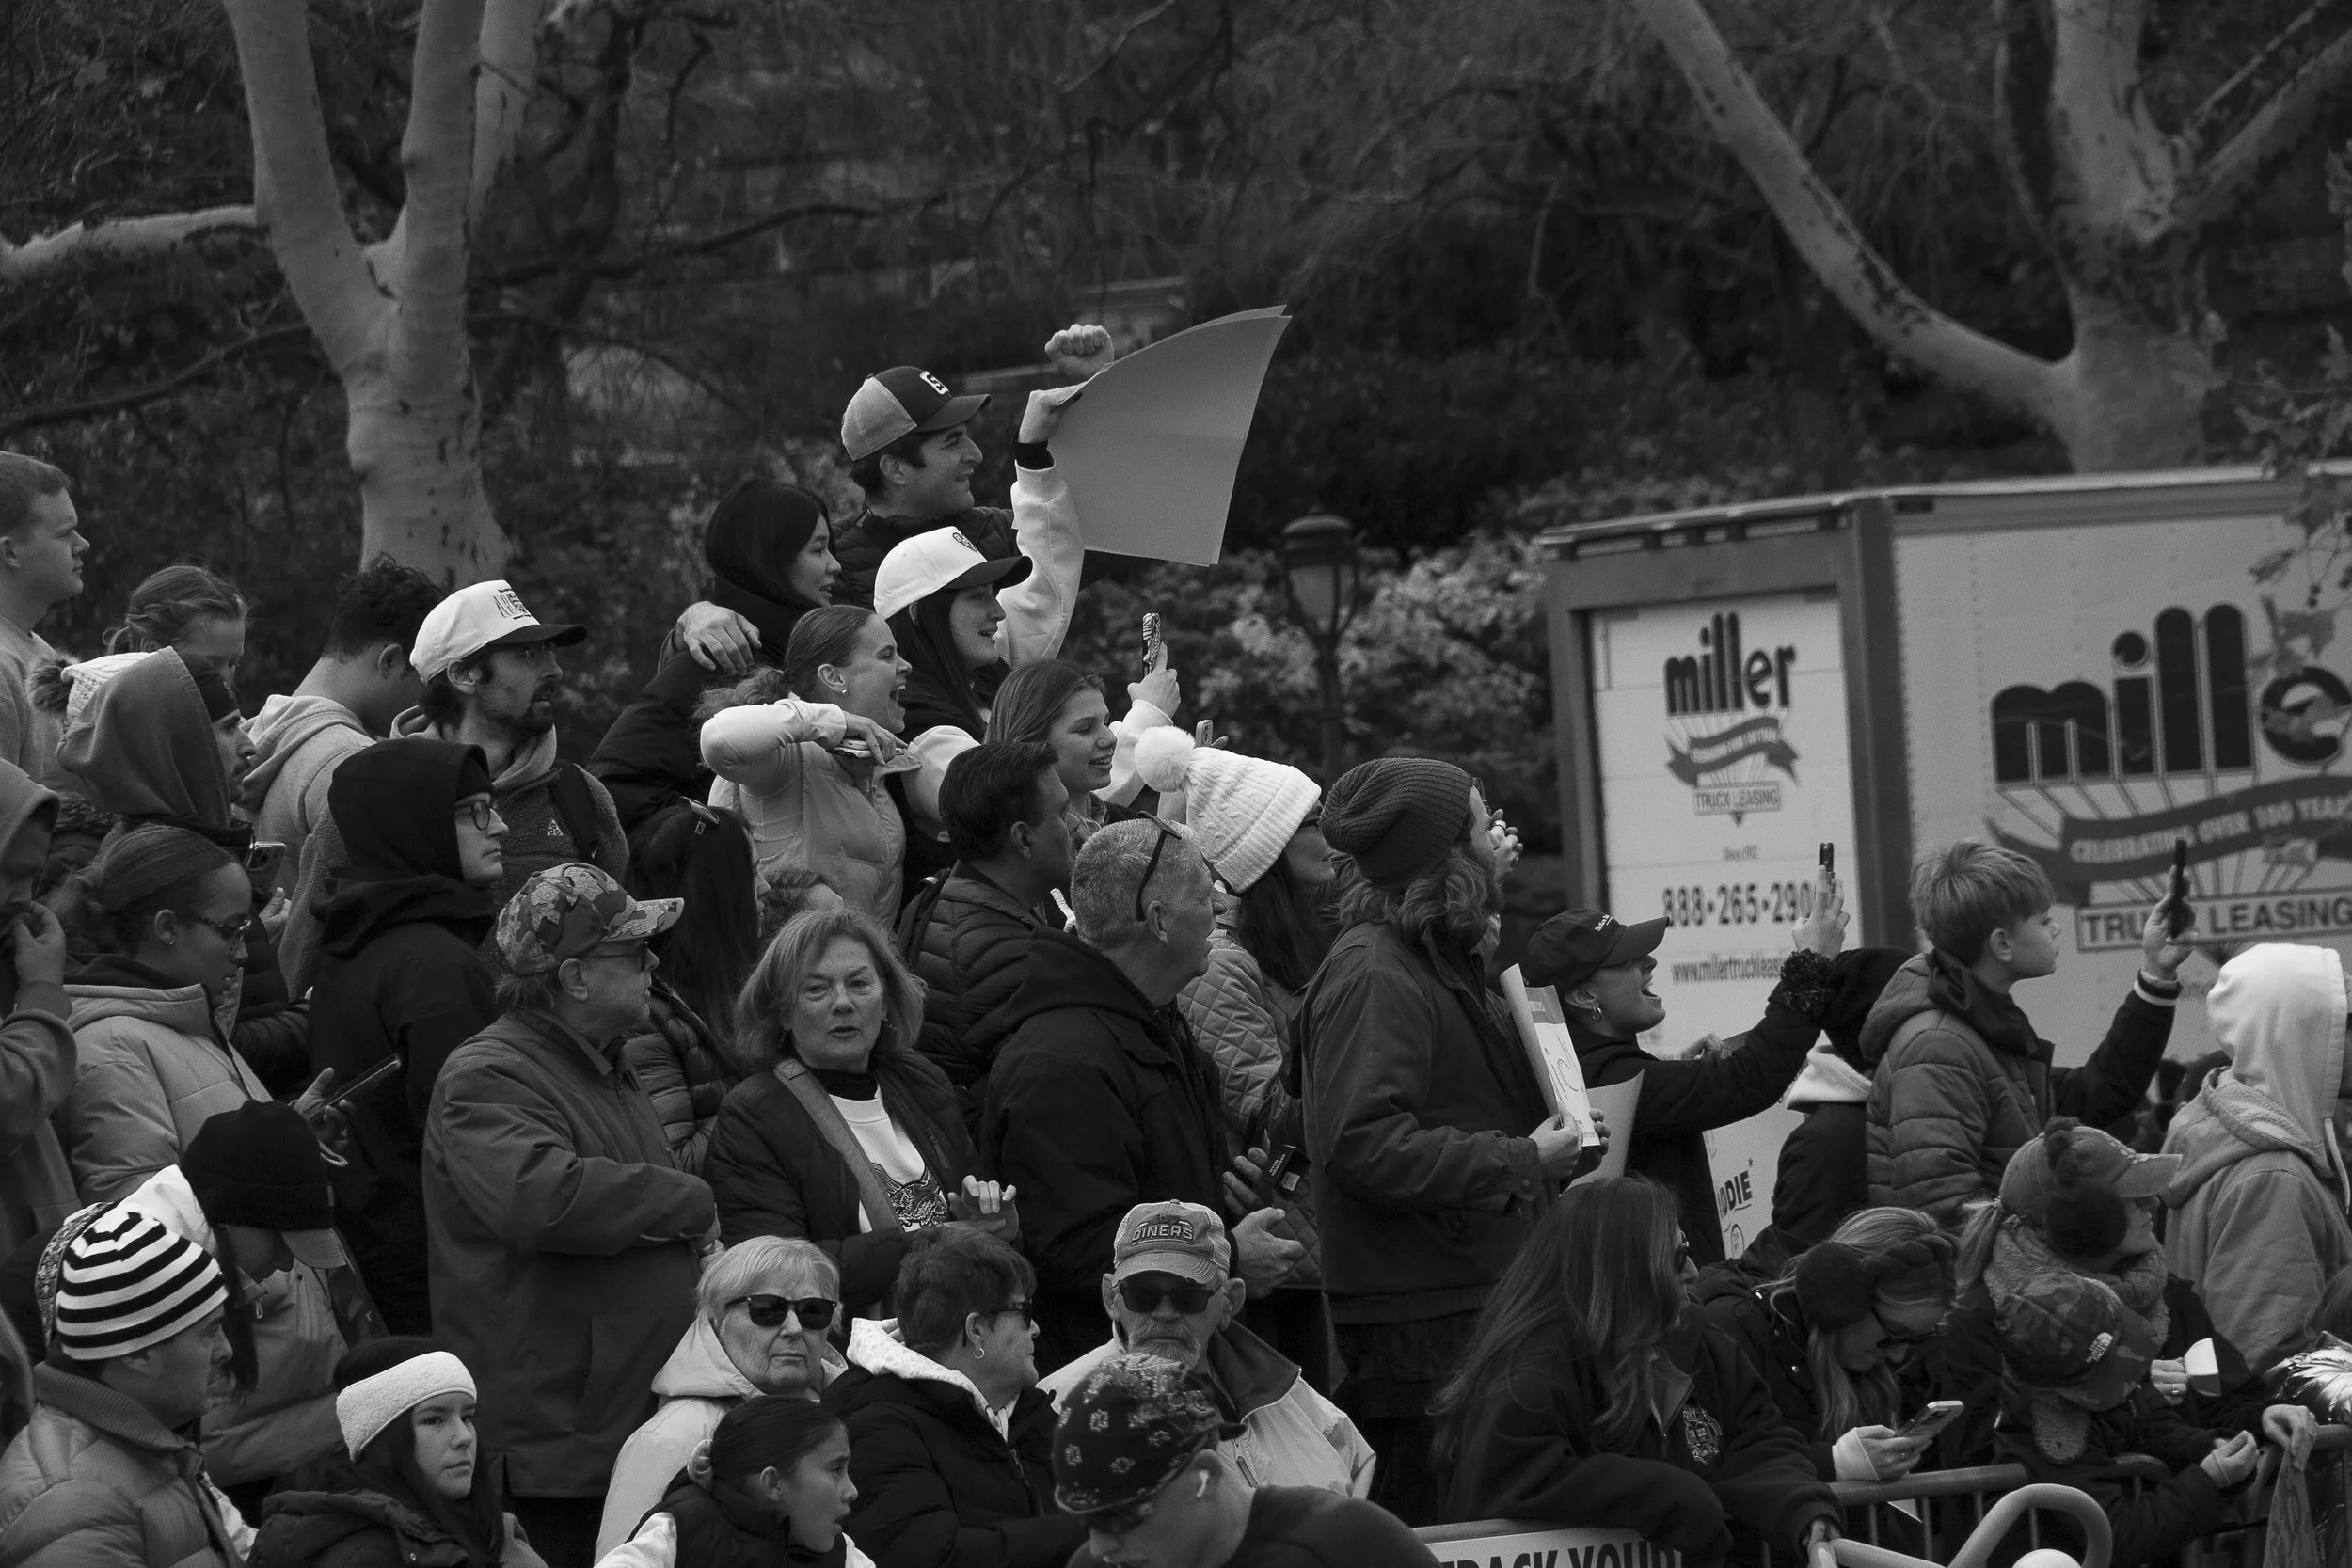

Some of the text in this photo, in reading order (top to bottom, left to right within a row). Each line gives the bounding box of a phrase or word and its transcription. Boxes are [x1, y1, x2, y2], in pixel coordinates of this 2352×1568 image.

[1663, 611, 1797, 716] miller
[1695, 788, 1780, 810] TRUCK LEASING
[2081, 895, 2352, 942] TRU LEASING
[1132, 1224, 1193, 1243] DINERS
